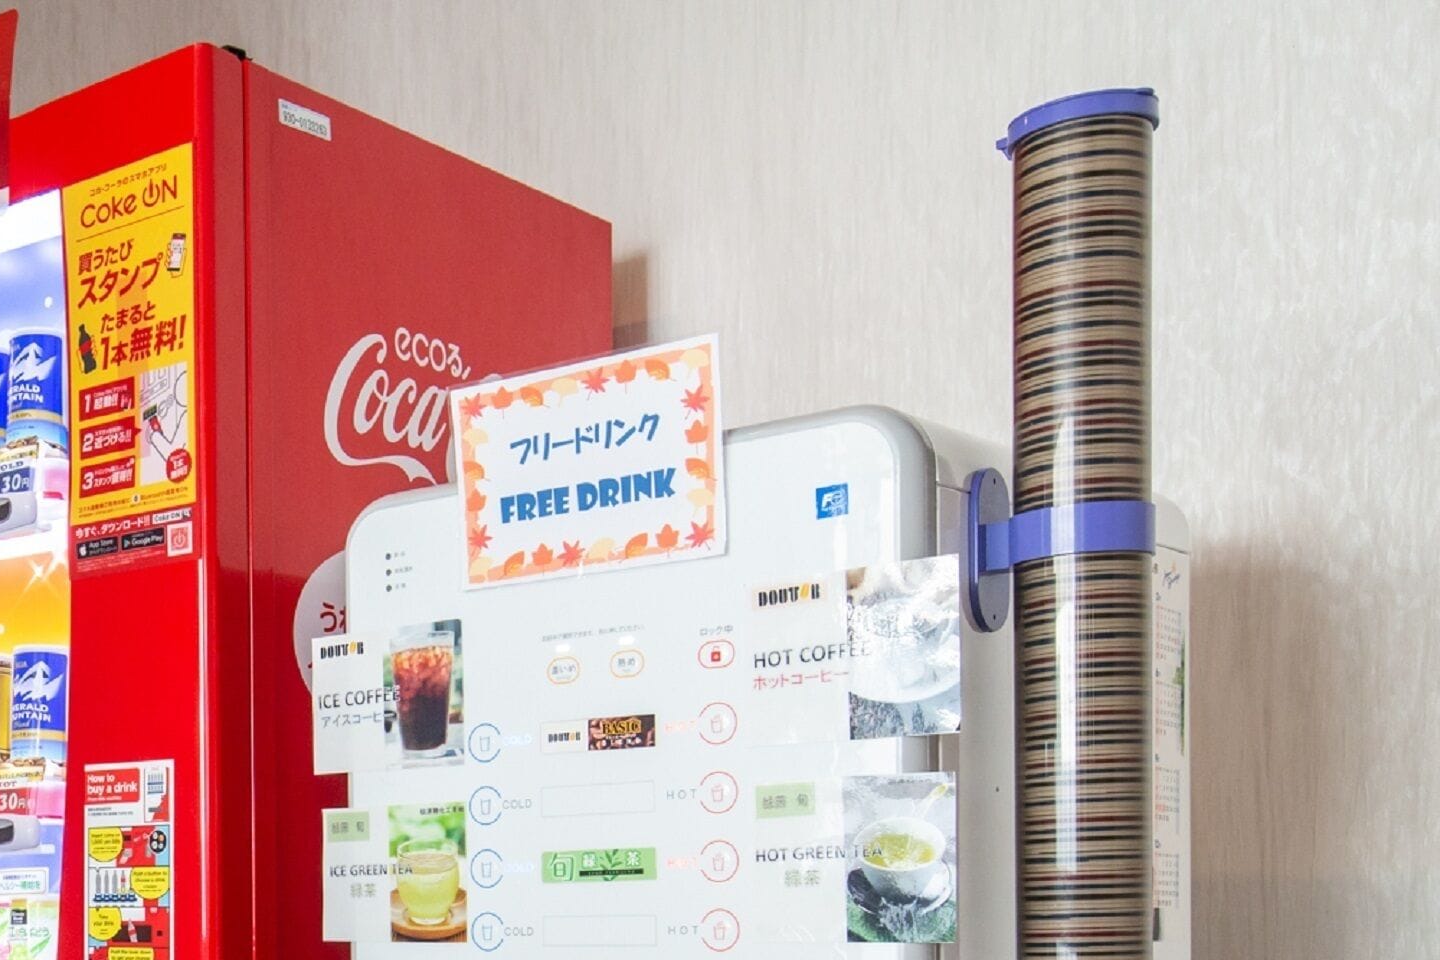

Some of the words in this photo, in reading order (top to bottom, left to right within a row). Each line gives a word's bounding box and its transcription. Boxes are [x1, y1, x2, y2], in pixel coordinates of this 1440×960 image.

[80, 198, 137, 229] Coke
[142, 174, 179, 208] ON
[78, 238, 133, 276] 買うたび
[78, 253, 163, 309] スタンプ
[99, 299, 156, 333] たまると
[100, 314, 188, 371] 1本無料!
[82, 432, 94, 453] 2
[510, 414, 659, 464] フリードリンク
[82, 471, 94, 490] 3
[500, 487, 570, 524] FREE
[576, 467, 676, 511] DRINK
[754, 649, 792, 669] HOT
[800, 641, 872, 664] COFFEE
[753, 669, 849, 691] ホットコーヒー
[319, 692, 341, 710] ICE
[345, 684, 400, 706] COFFEE
[602, 722, 639, 735] BASIC
[87, 775, 105, 783] How
[106, 774, 115, 782] to
[87, 785, 104, 796] buy
[106, 785, 112, 793] a
[114, 781, 137, 793] drink
[502, 799, 532, 810] COLD
[666, 789, 697, 800] HOT
[756, 847, 787, 863] HOT
[792, 845, 846, 861] GREEN
[854, 843, 882, 858] TEA
[329, 865, 346, 877] ICE
[349, 863, 388, 877] GREEN
[391, 863, 413, 875] TEA
[504, 927, 534, 938] COLD
[668, 926, 699, 936] HOT
